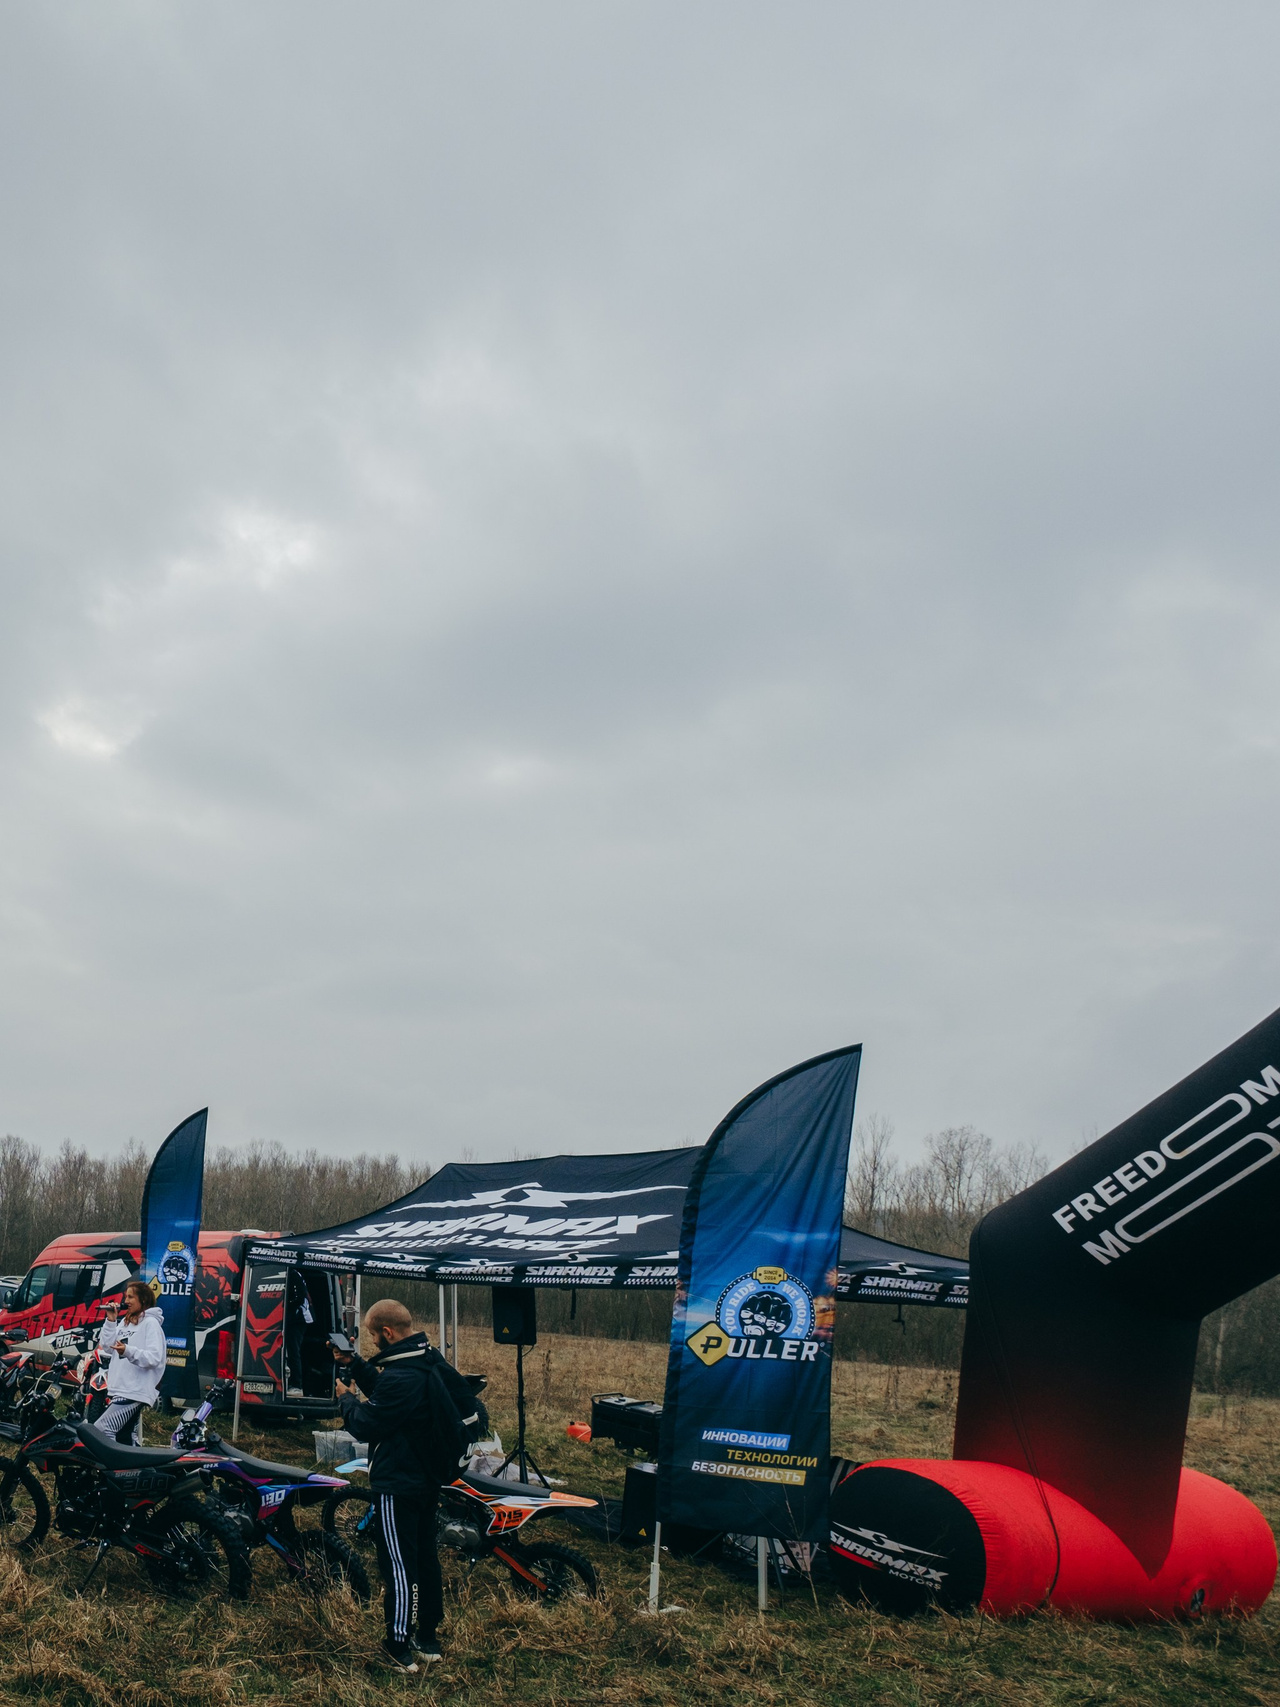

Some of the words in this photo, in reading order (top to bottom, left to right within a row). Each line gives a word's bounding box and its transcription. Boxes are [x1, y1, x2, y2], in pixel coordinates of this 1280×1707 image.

[1052, 1064, 1280, 1234] FREEDOM
[337, 1213, 674, 1238] SHARMAX
[250, 1247, 298, 1258] SHARMAX
[304, 1252, 360, 1266] SHARMAX
[364, 1260, 430, 1273] SHARMAX
[435, 1266, 515, 1275] SHARMAX
[525, 1266, 618, 1277] SHARMAX
[782, 1283, 799, 1299] WE
[861, 1276, 944, 1293] SHARMAX
[729, 1282, 757, 1307] RIDE
[910, 1292, 938, 1301] RACE
[725, 1308, 737, 1334] YOU
[793, 1298, 807, 1337] WORK
[701, 1336, 819, 1361] PULLER
[702, 1430, 788, 1448] ИННОВАЦИИ
[727, 1449, 818, 1467] ТЕХНОЛОГИИ
[691, 1461, 801, 1482] БЕЗОПАСНОСТЬ
[830, 1530, 949, 1582] SHARMAX
[888, 1568, 942, 1590] MOTORS
[411, 1583, 419, 1626] adidas
